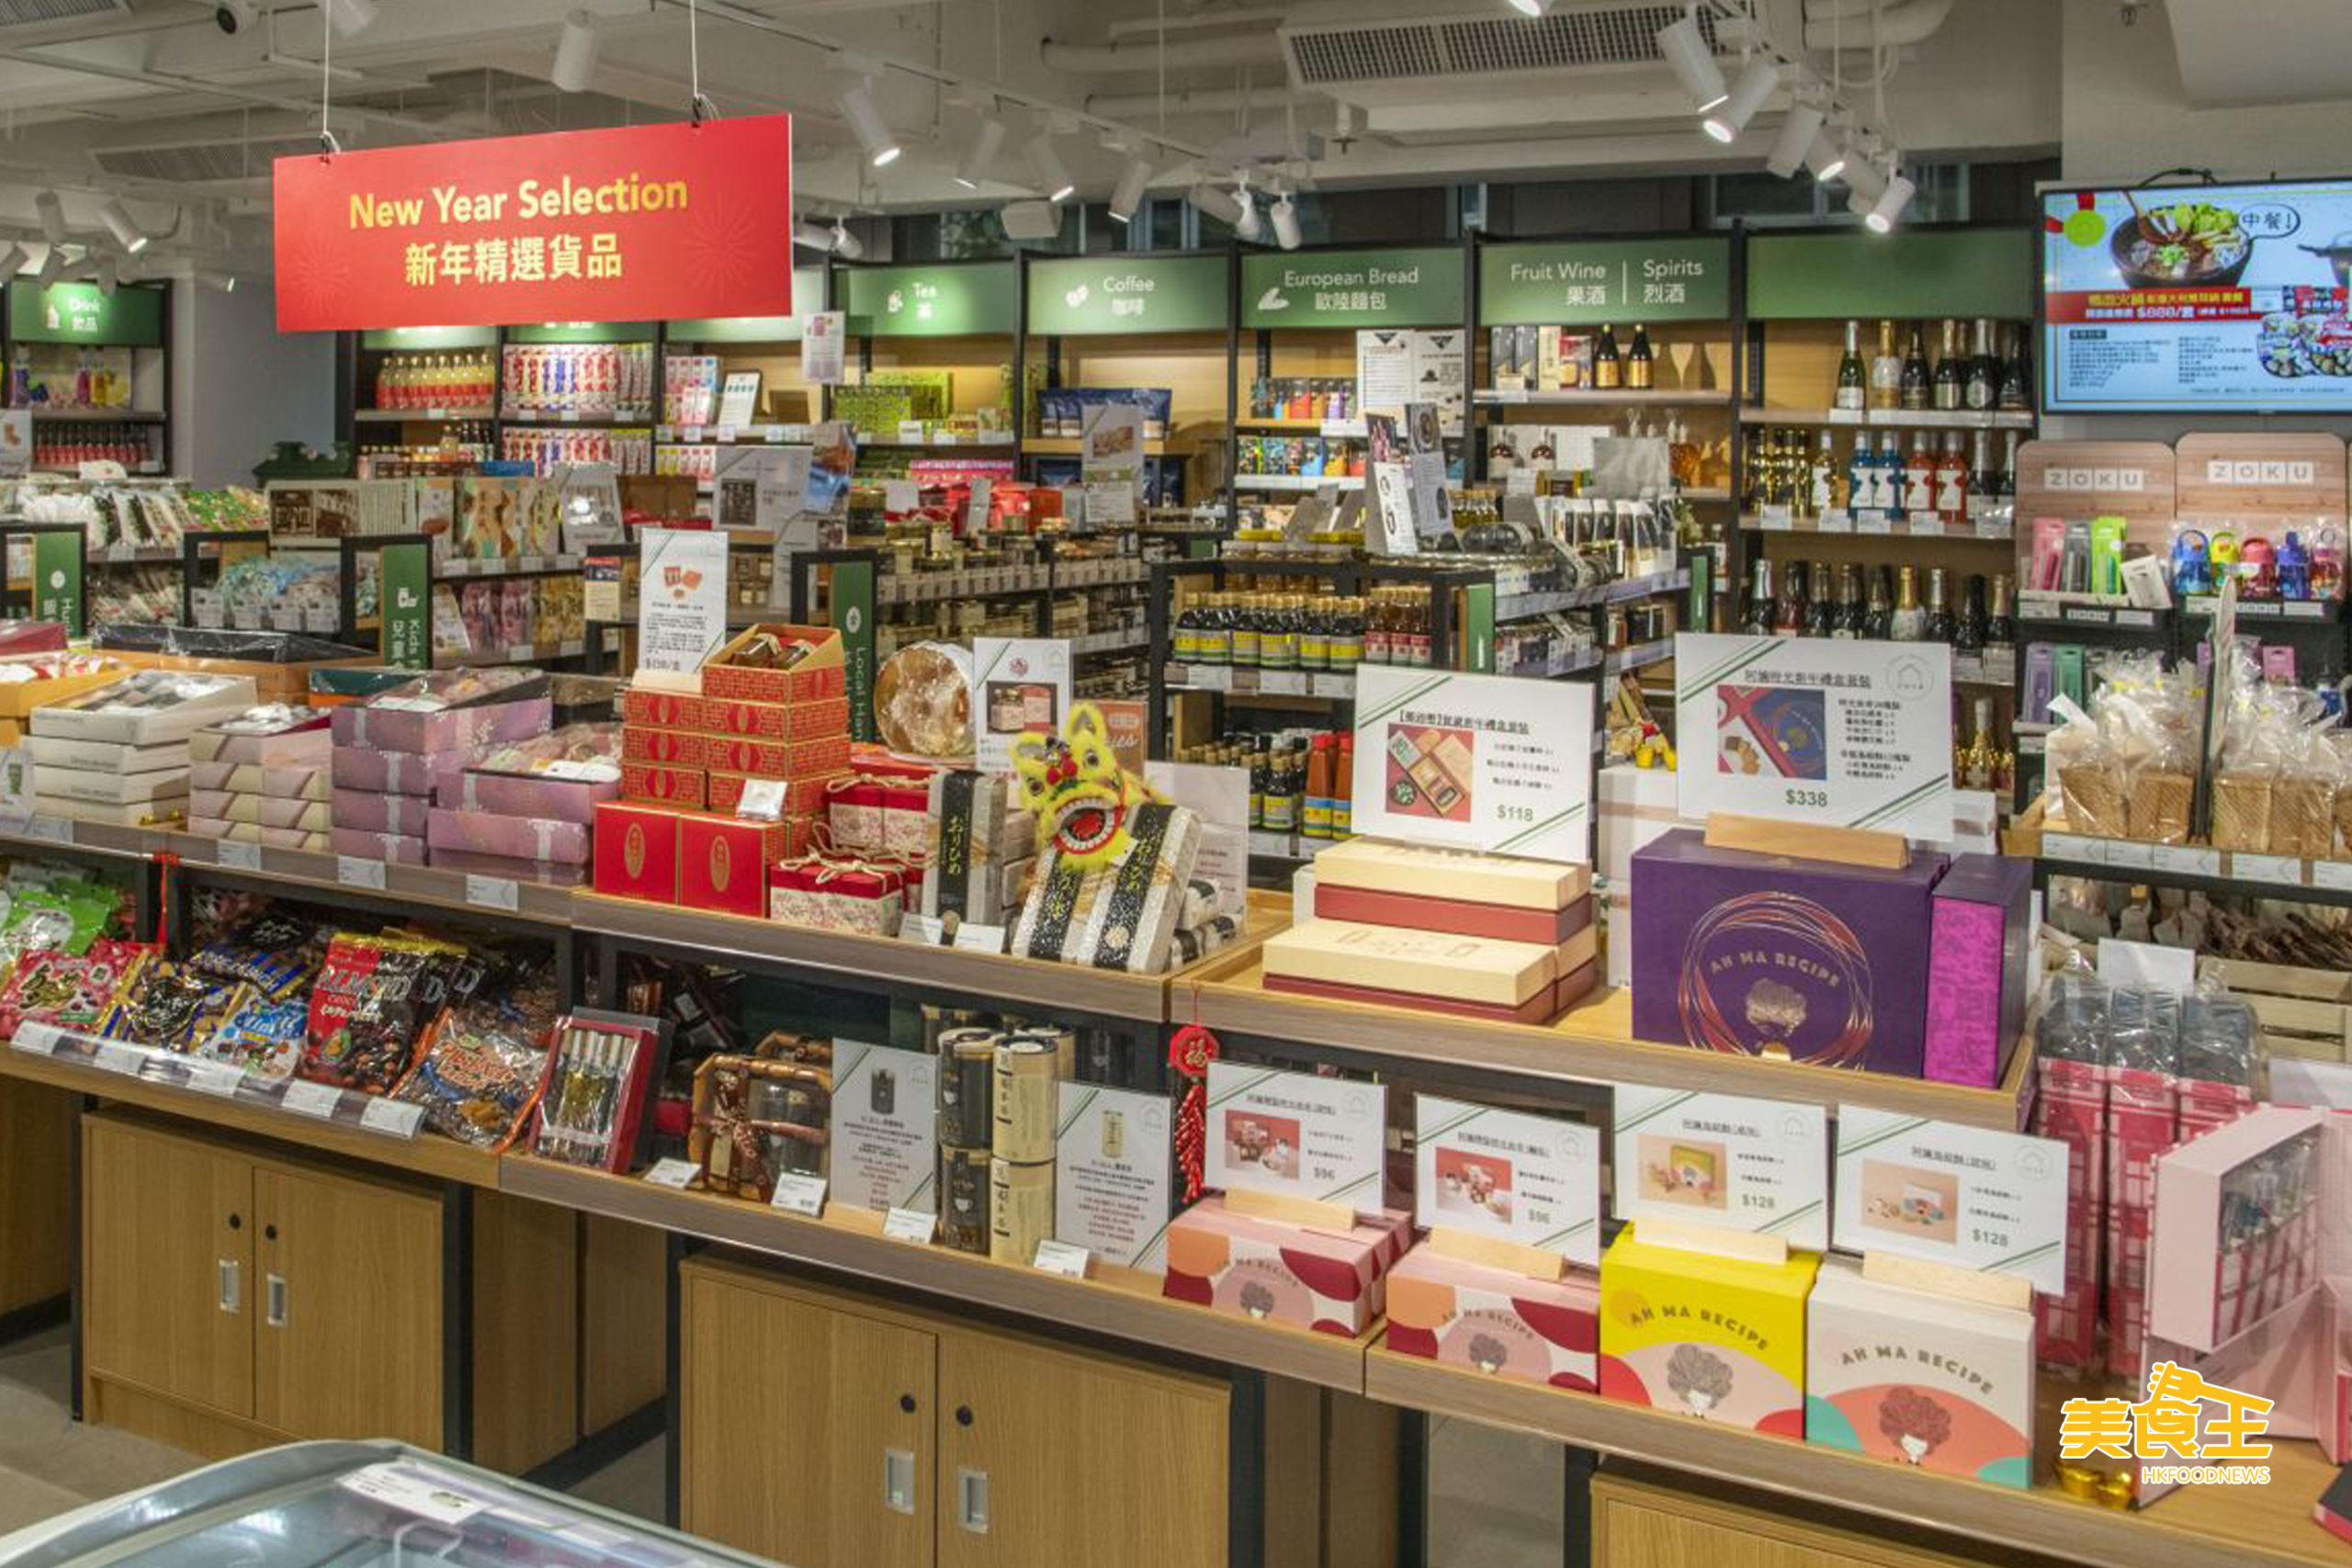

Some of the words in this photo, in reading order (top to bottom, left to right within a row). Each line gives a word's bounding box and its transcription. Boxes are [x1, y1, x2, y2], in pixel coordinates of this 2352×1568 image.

[349, 192, 424, 230] New
[431, 186, 508, 224] Year
[518, 173, 688, 220] Selection
[405, 233, 623, 288] 新年精選貨品
[1644, 259, 1703, 279] Spirits
[1284, 269, 1364, 290] European
[1369, 266, 1419, 286] Bread
[1510, 264, 1553, 281] Fruit
[1559, 263, 1607, 279] Wine
[912, 282, 937, 299] Tea
[1102, 276, 1156, 293] Coffee
[1644, 283, 1686, 304] 烈酒
[1566, 286, 1606, 306] 果酒
[2048, 471, 2141, 488] ZOKU
[2212, 464, 2310, 479] ZOKU
[1785, 789, 1828, 807] $338
[1497, 804, 1533, 822] $118
[1710, 954, 1734, 974] AH
[1740, 952, 1768, 964] MA
[1774, 952, 1840, 987] RECIPE
[1741, 1194, 1776, 1209] $128
[1972, 1229, 2009, 1247] $128
[1630, 1307, 1655, 1326] AH
[1662, 1304, 1691, 1319] MA
[1700, 1308, 1770, 1352] RECIPE
[1840, 1348, 1869, 1367] AH
[1875, 1345, 1908, 1359] MA
[1917, 1349, 1994, 1395] RECIPE
